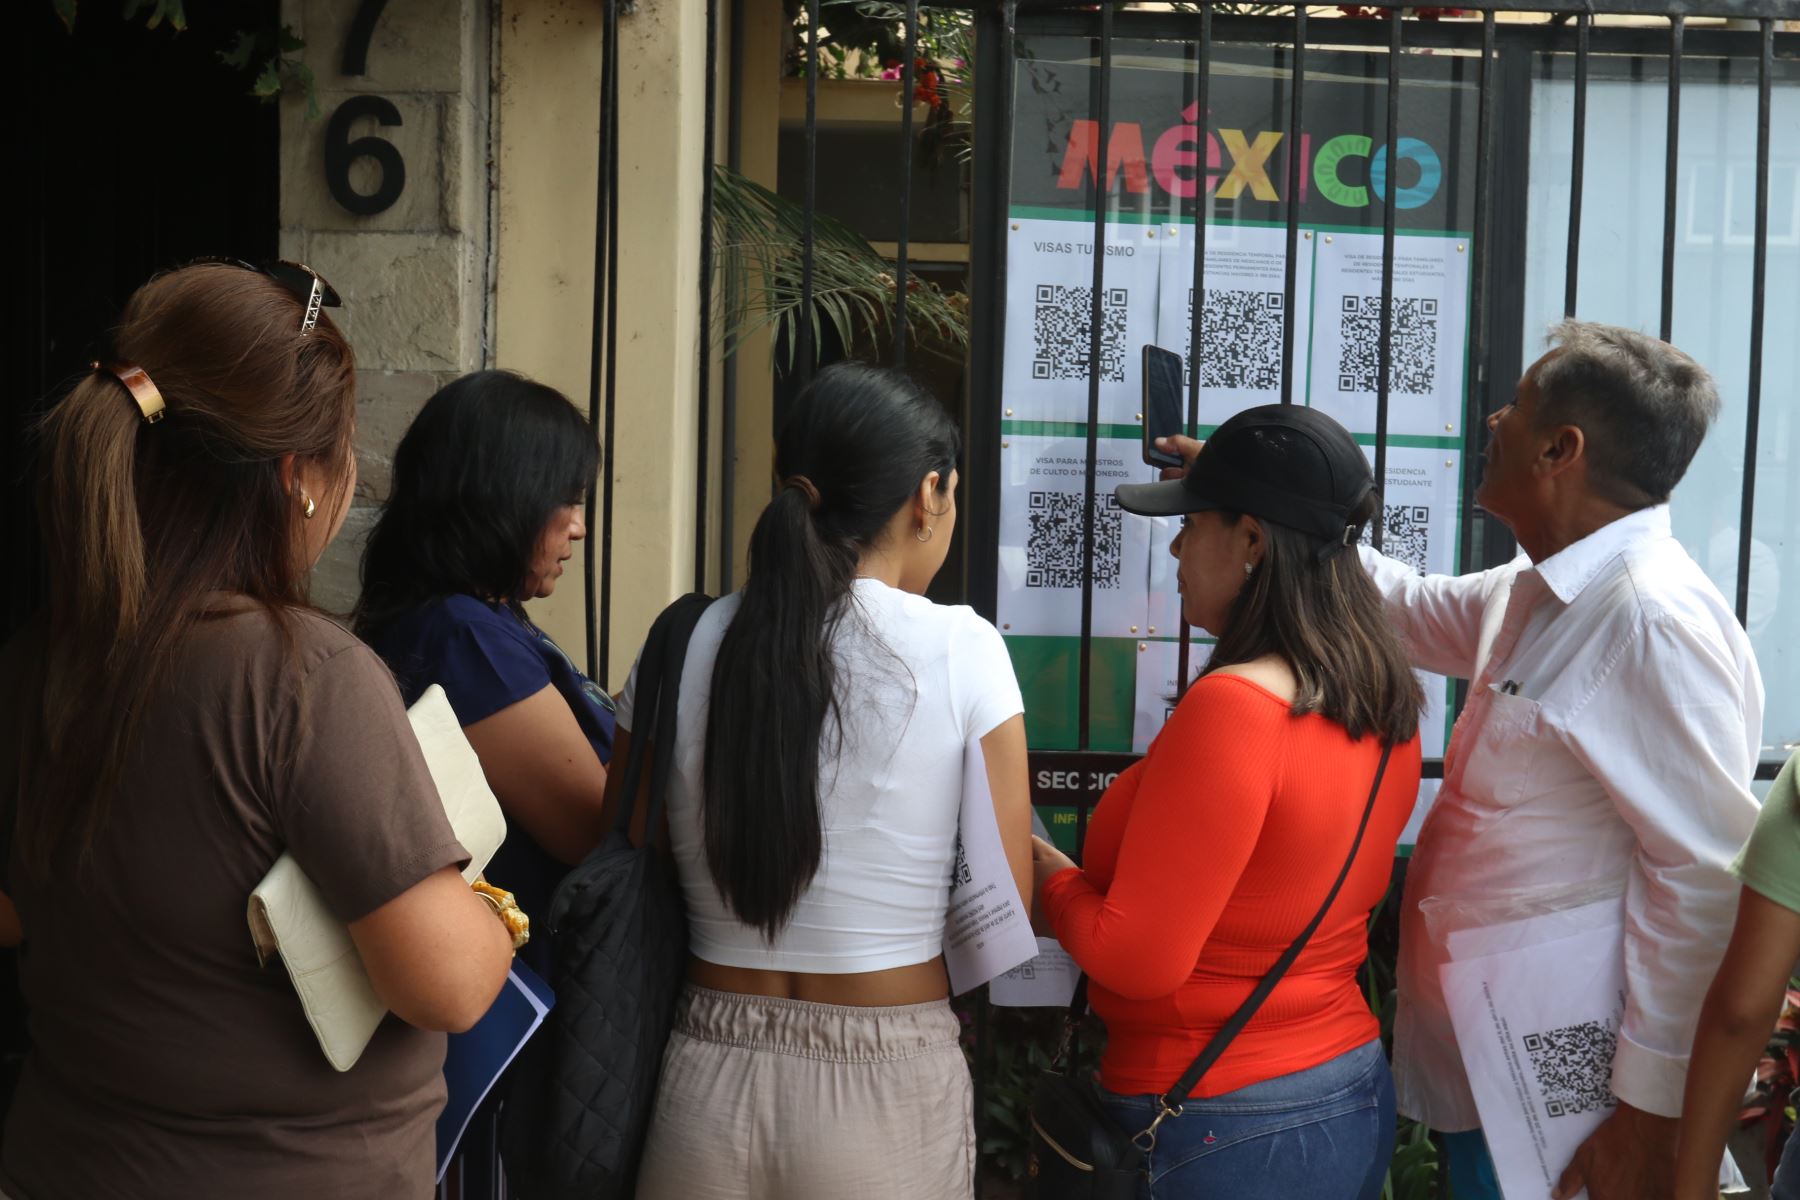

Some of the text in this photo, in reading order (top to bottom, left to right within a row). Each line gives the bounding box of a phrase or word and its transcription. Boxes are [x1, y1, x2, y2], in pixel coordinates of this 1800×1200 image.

[1033, 241, 1135, 257] VISAS TUSMO
[1056, 457, 1078, 465] PARA
[1079, 458, 1124, 467] MSTROS
[1042, 468, 1069, 476] CULTO
[1079, 469, 1129, 478] MONEROS
[1384, 467, 1426, 476] ESIDENCIA
[1037, 770, 1120, 791] SECCIO
